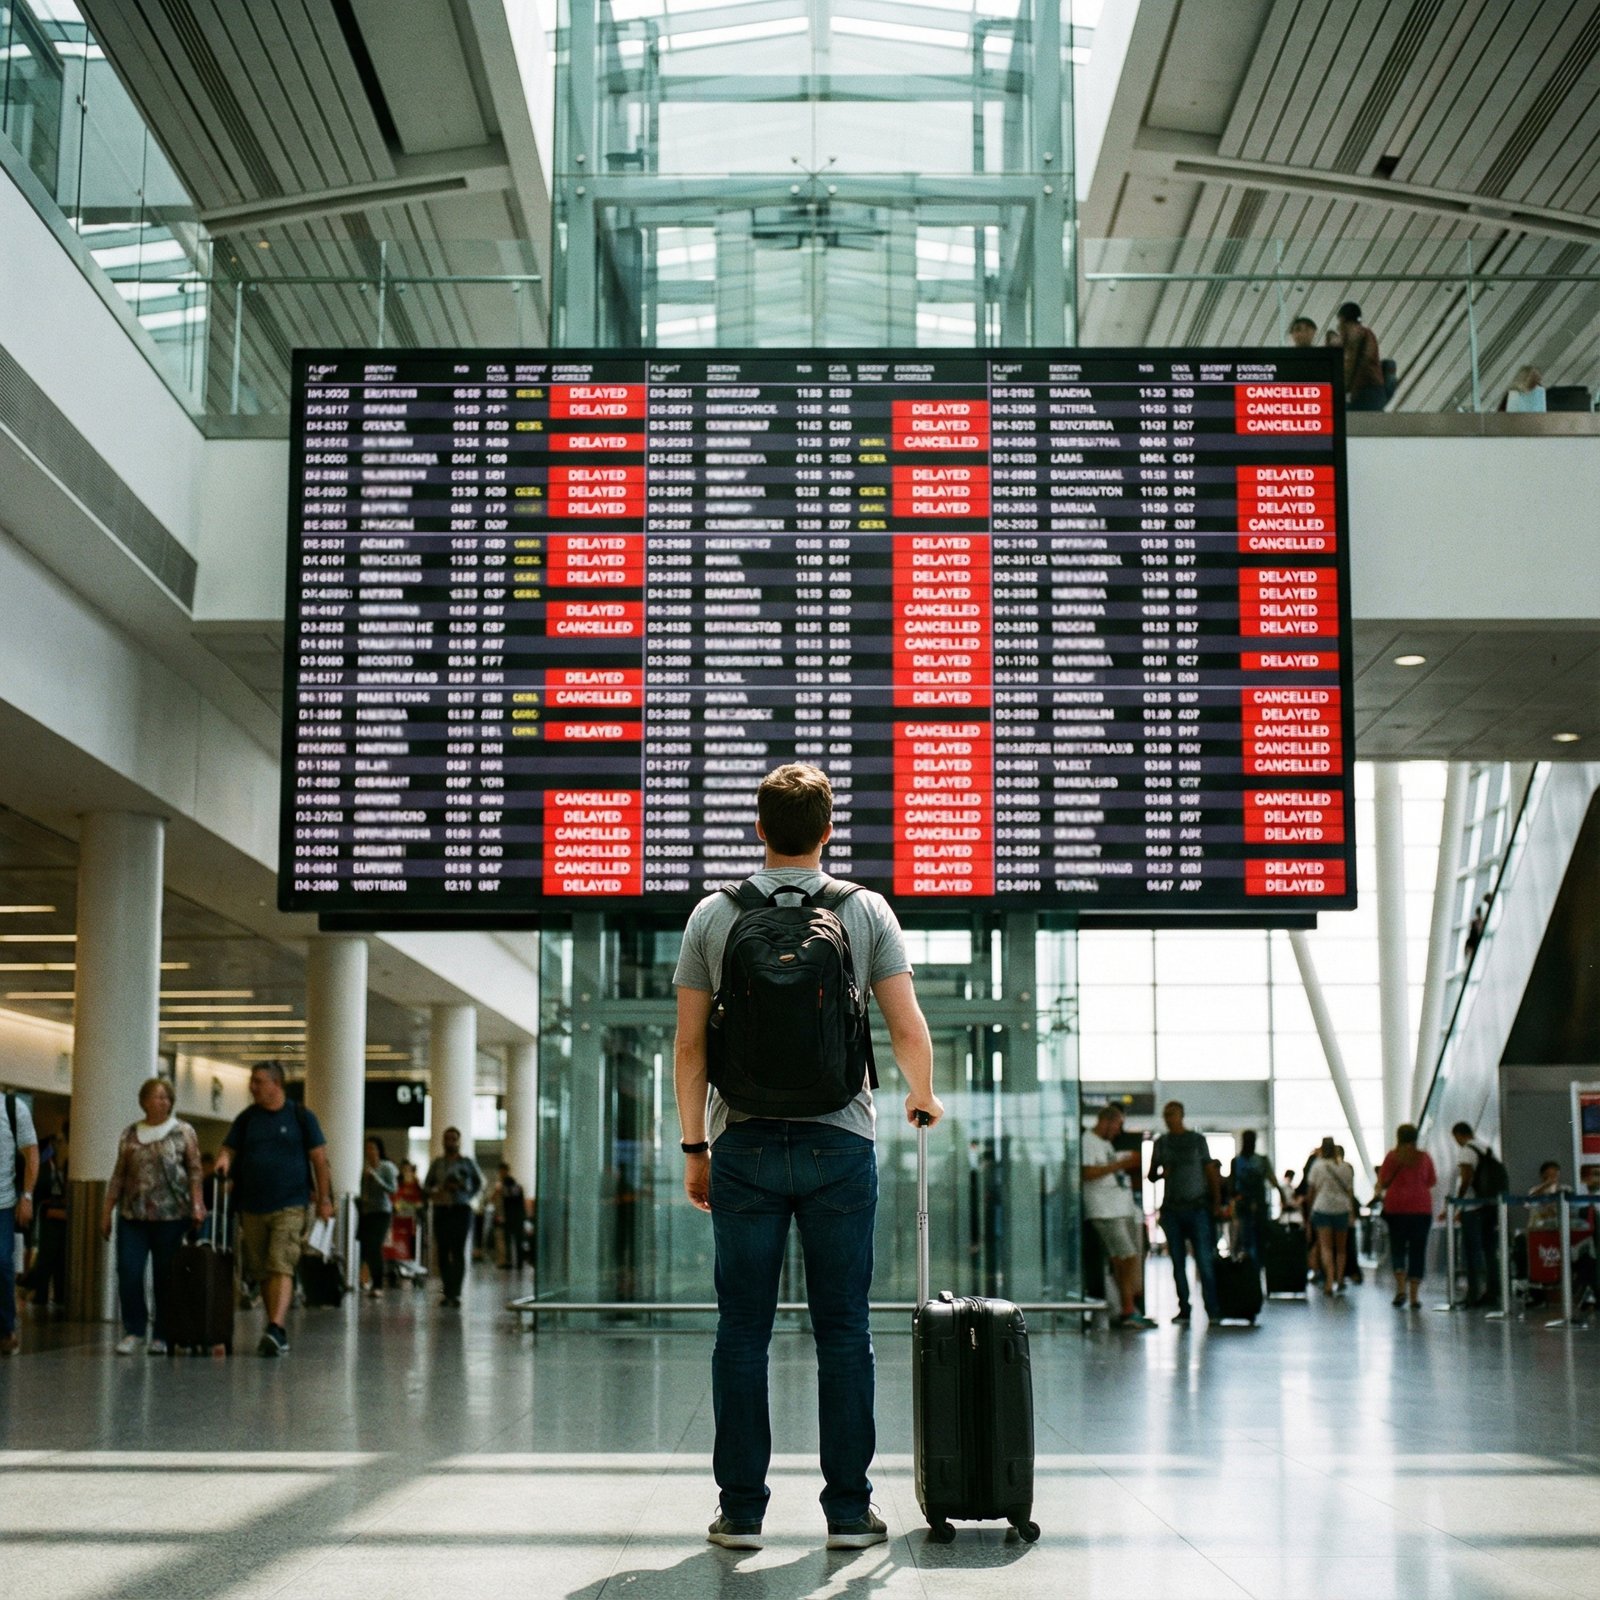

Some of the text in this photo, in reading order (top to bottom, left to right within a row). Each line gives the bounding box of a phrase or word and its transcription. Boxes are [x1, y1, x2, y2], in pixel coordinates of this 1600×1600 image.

[569, 387, 628, 399] DELAYED
[1246, 386, 1321, 399] CANCELLED
[569, 403, 628, 416] DELAYED
[911, 403, 971, 416] DELAYED
[1246, 403, 1321, 415] CANCELLED
[911, 419, 971, 432] DELAYED
[1247, 419, 1322, 432] CANCELLED
[568, 436, 628, 449] DELAYED
[903, 435, 980, 449] CANCELLED
[568, 469, 627, 482] DELAYED
[911, 468, 971, 481] DELAYED
[1256, 468, 1315, 481] DELAYED
[568, 485, 627, 498] DELAYED
[911, 485, 971, 498] DELAYED
[1256, 485, 1315, 498] DELAYED
[567, 502, 627, 515] DELAYED
[912, 501, 971, 514] DELAYED
[1257, 502, 1316, 514] DELAYED
[1248, 518, 1325, 531] CANCELLED
[567, 537, 626, 550] DELAYED
[912, 537, 971, 550] DELAYED
[1248, 537, 1326, 550] CANCELLED
[567, 554, 626, 567] DELAYED
[912, 553, 971, 567] DELAYED
[566, 570, 626, 583] DELAYED
[912, 570, 971, 583] DELAYED
[1258, 570, 1318, 583] DELAYED
[912, 587, 972, 600] DELAYED
[1259, 587, 1318, 600] DELAYED
[566, 604, 625, 617] DELAYED
[903, 603, 981, 617] CANCELLED
[1259, 604, 1318, 617] DELAYED
[556, 621, 634, 634] CANCELLED
[904, 620, 981, 634] CANCELLED
[1259, 621, 1319, 634] DELAYED
[904, 637, 981, 651] CANCELLED
[912, 654, 972, 667] DELAYED
[1260, 654, 1319, 667] DELAYED
[565, 671, 625, 684] DELAYED
[912, 671, 972, 684] DELAYED
[555, 690, 633, 704] CANCELLED
[912, 691, 972, 704] DELAYED
[1253, 690, 1329, 704] CANCELLED
[1261, 708, 1321, 721] DELAYED
[564, 725, 623, 738] DELAYED
[904, 724, 981, 738] CANCELLED
[1254, 724, 1330, 738] CANCELLED
[912, 741, 972, 755] DELAYED
[1254, 741, 1331, 755] CANCELLED
[913, 758, 973, 772] DELAYED
[1254, 759, 1330, 772] CANCELLED
[912, 775, 973, 789] DELAYED
[554, 792, 632, 806] CANCELLED
[904, 792, 982, 807] CANCELLED
[1254, 792, 1331, 806] CANCELLED
[563, 810, 623, 824] DELAYED
[904, 810, 982, 824] CANCELLED
[1263, 810, 1323, 823] DELAYED
[554, 827, 631, 841] CANCELLED
[904, 827, 982, 841] CANCELLED
[1264, 827, 1324, 841] DELAYED
[554, 844, 632, 858] CANCELLED
[913, 844, 973, 858] DELAYED
[554, 861, 631, 875] CANCELLED
[913, 861, 973, 875] DELAYED
[1264, 861, 1325, 875] DELAYED
[562, 879, 622, 892] DELAYED
[913, 879, 973, 892] DELAYED
[1265, 879, 1325, 892] DELAYED
